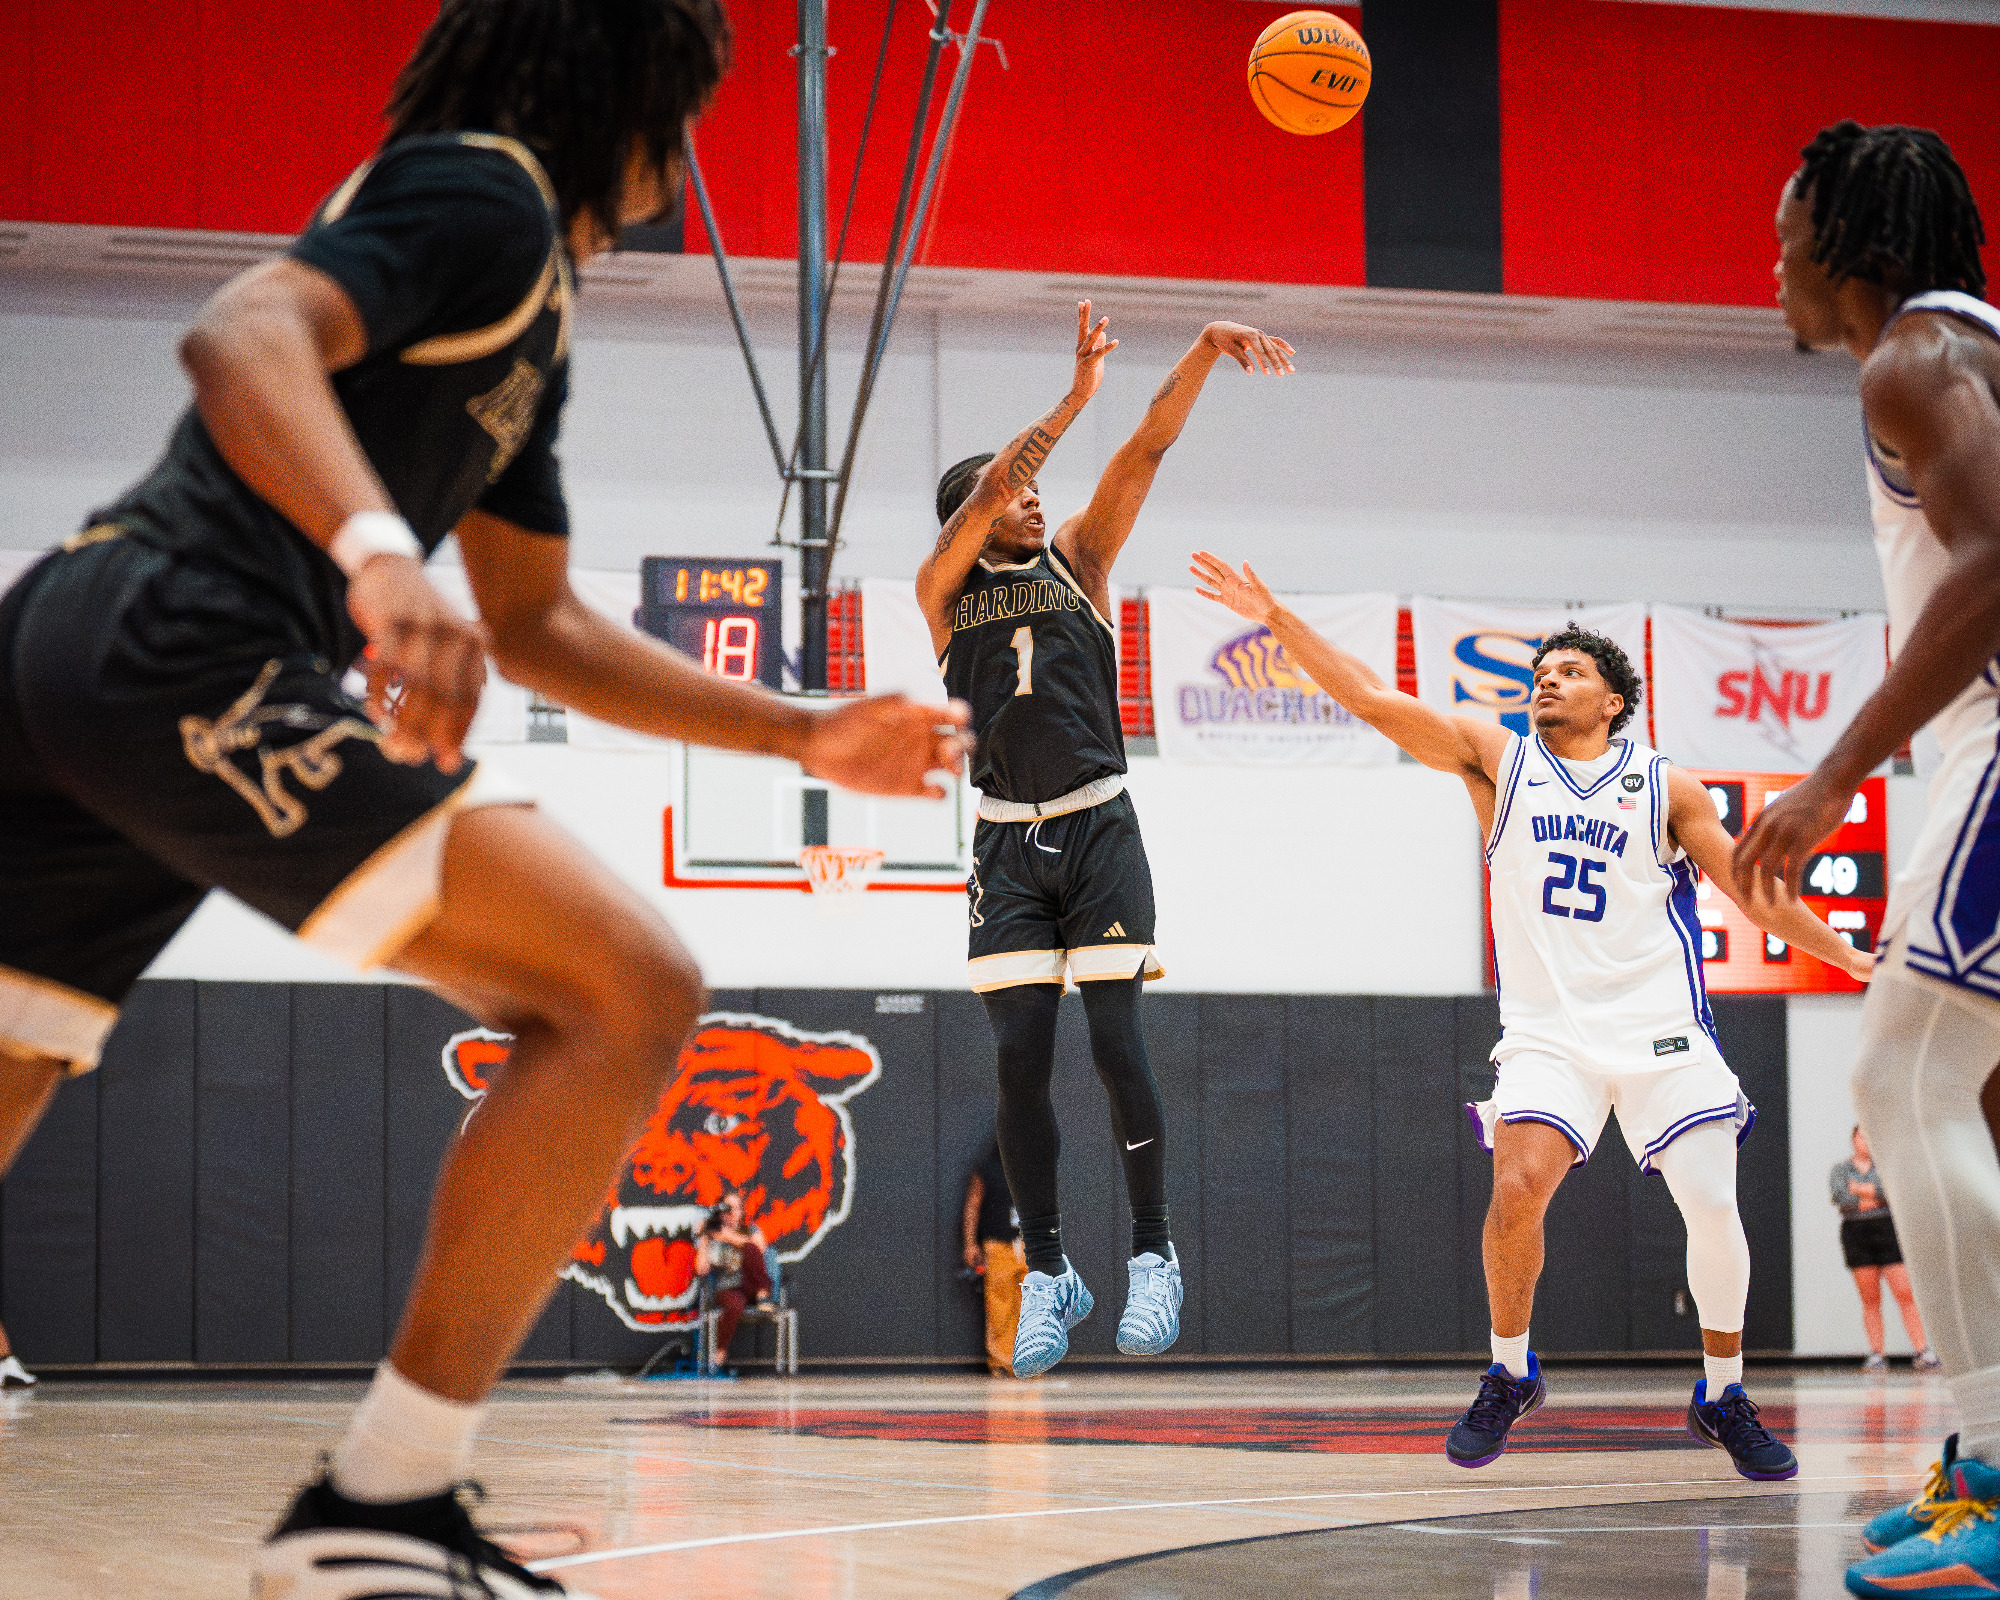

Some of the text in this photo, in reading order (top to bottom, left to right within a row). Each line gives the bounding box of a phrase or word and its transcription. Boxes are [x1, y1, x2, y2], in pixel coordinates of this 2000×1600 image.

[1295, 27, 1367, 59] Wilson
[1310, 69, 1358, 93] EVO
[1012, 427, 1056, 482] ONE
[676, 568, 768, 606] 11:42
[954, 580, 1081, 631] HARDING
[703, 616, 758, 682] 18
[1010, 626, 1034, 696] 1
[1714, 661, 1832, 731] SNU
[1532, 814, 1629, 858] OUACHITA
[1542, 852, 1607, 922] 25
